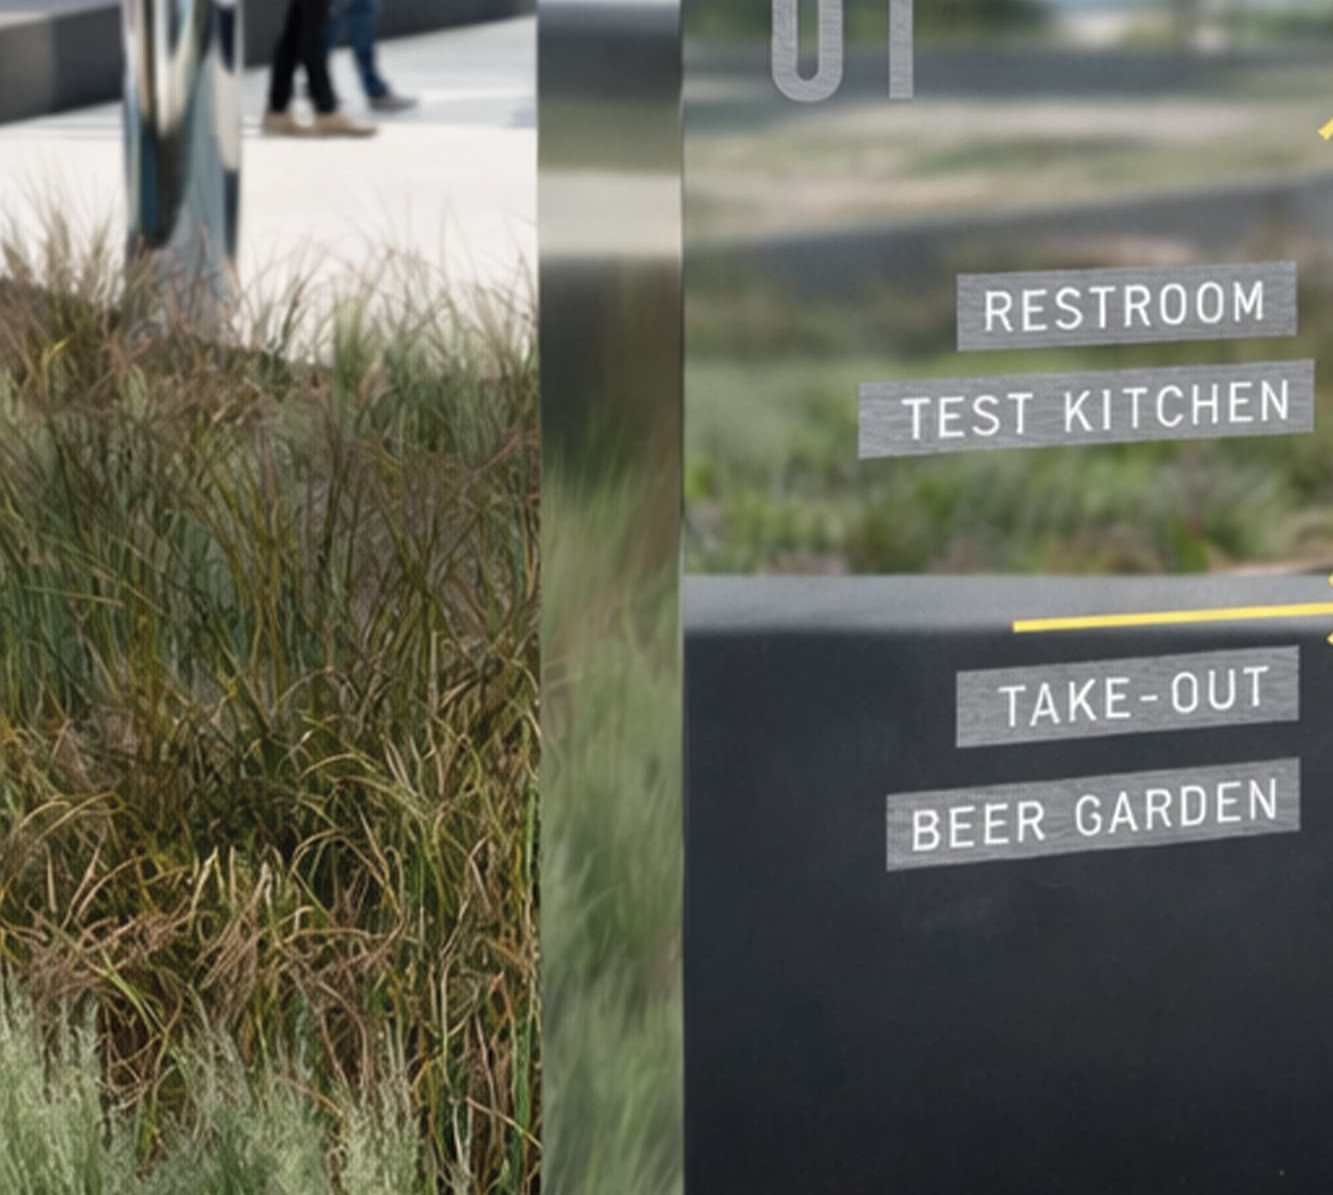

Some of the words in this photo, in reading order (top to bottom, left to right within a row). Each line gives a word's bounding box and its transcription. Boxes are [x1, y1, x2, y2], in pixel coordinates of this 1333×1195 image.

[984, 280, 1266, 333] RESTROOM
[901, 392, 1034, 440] TEST
[1063, 379, 1290, 433] KITCHEN
[997, 665, 1270, 728] TAKE-OUT
[911, 801, 1046, 852] BEER
[1074, 778, 1278, 838] GARDEN
